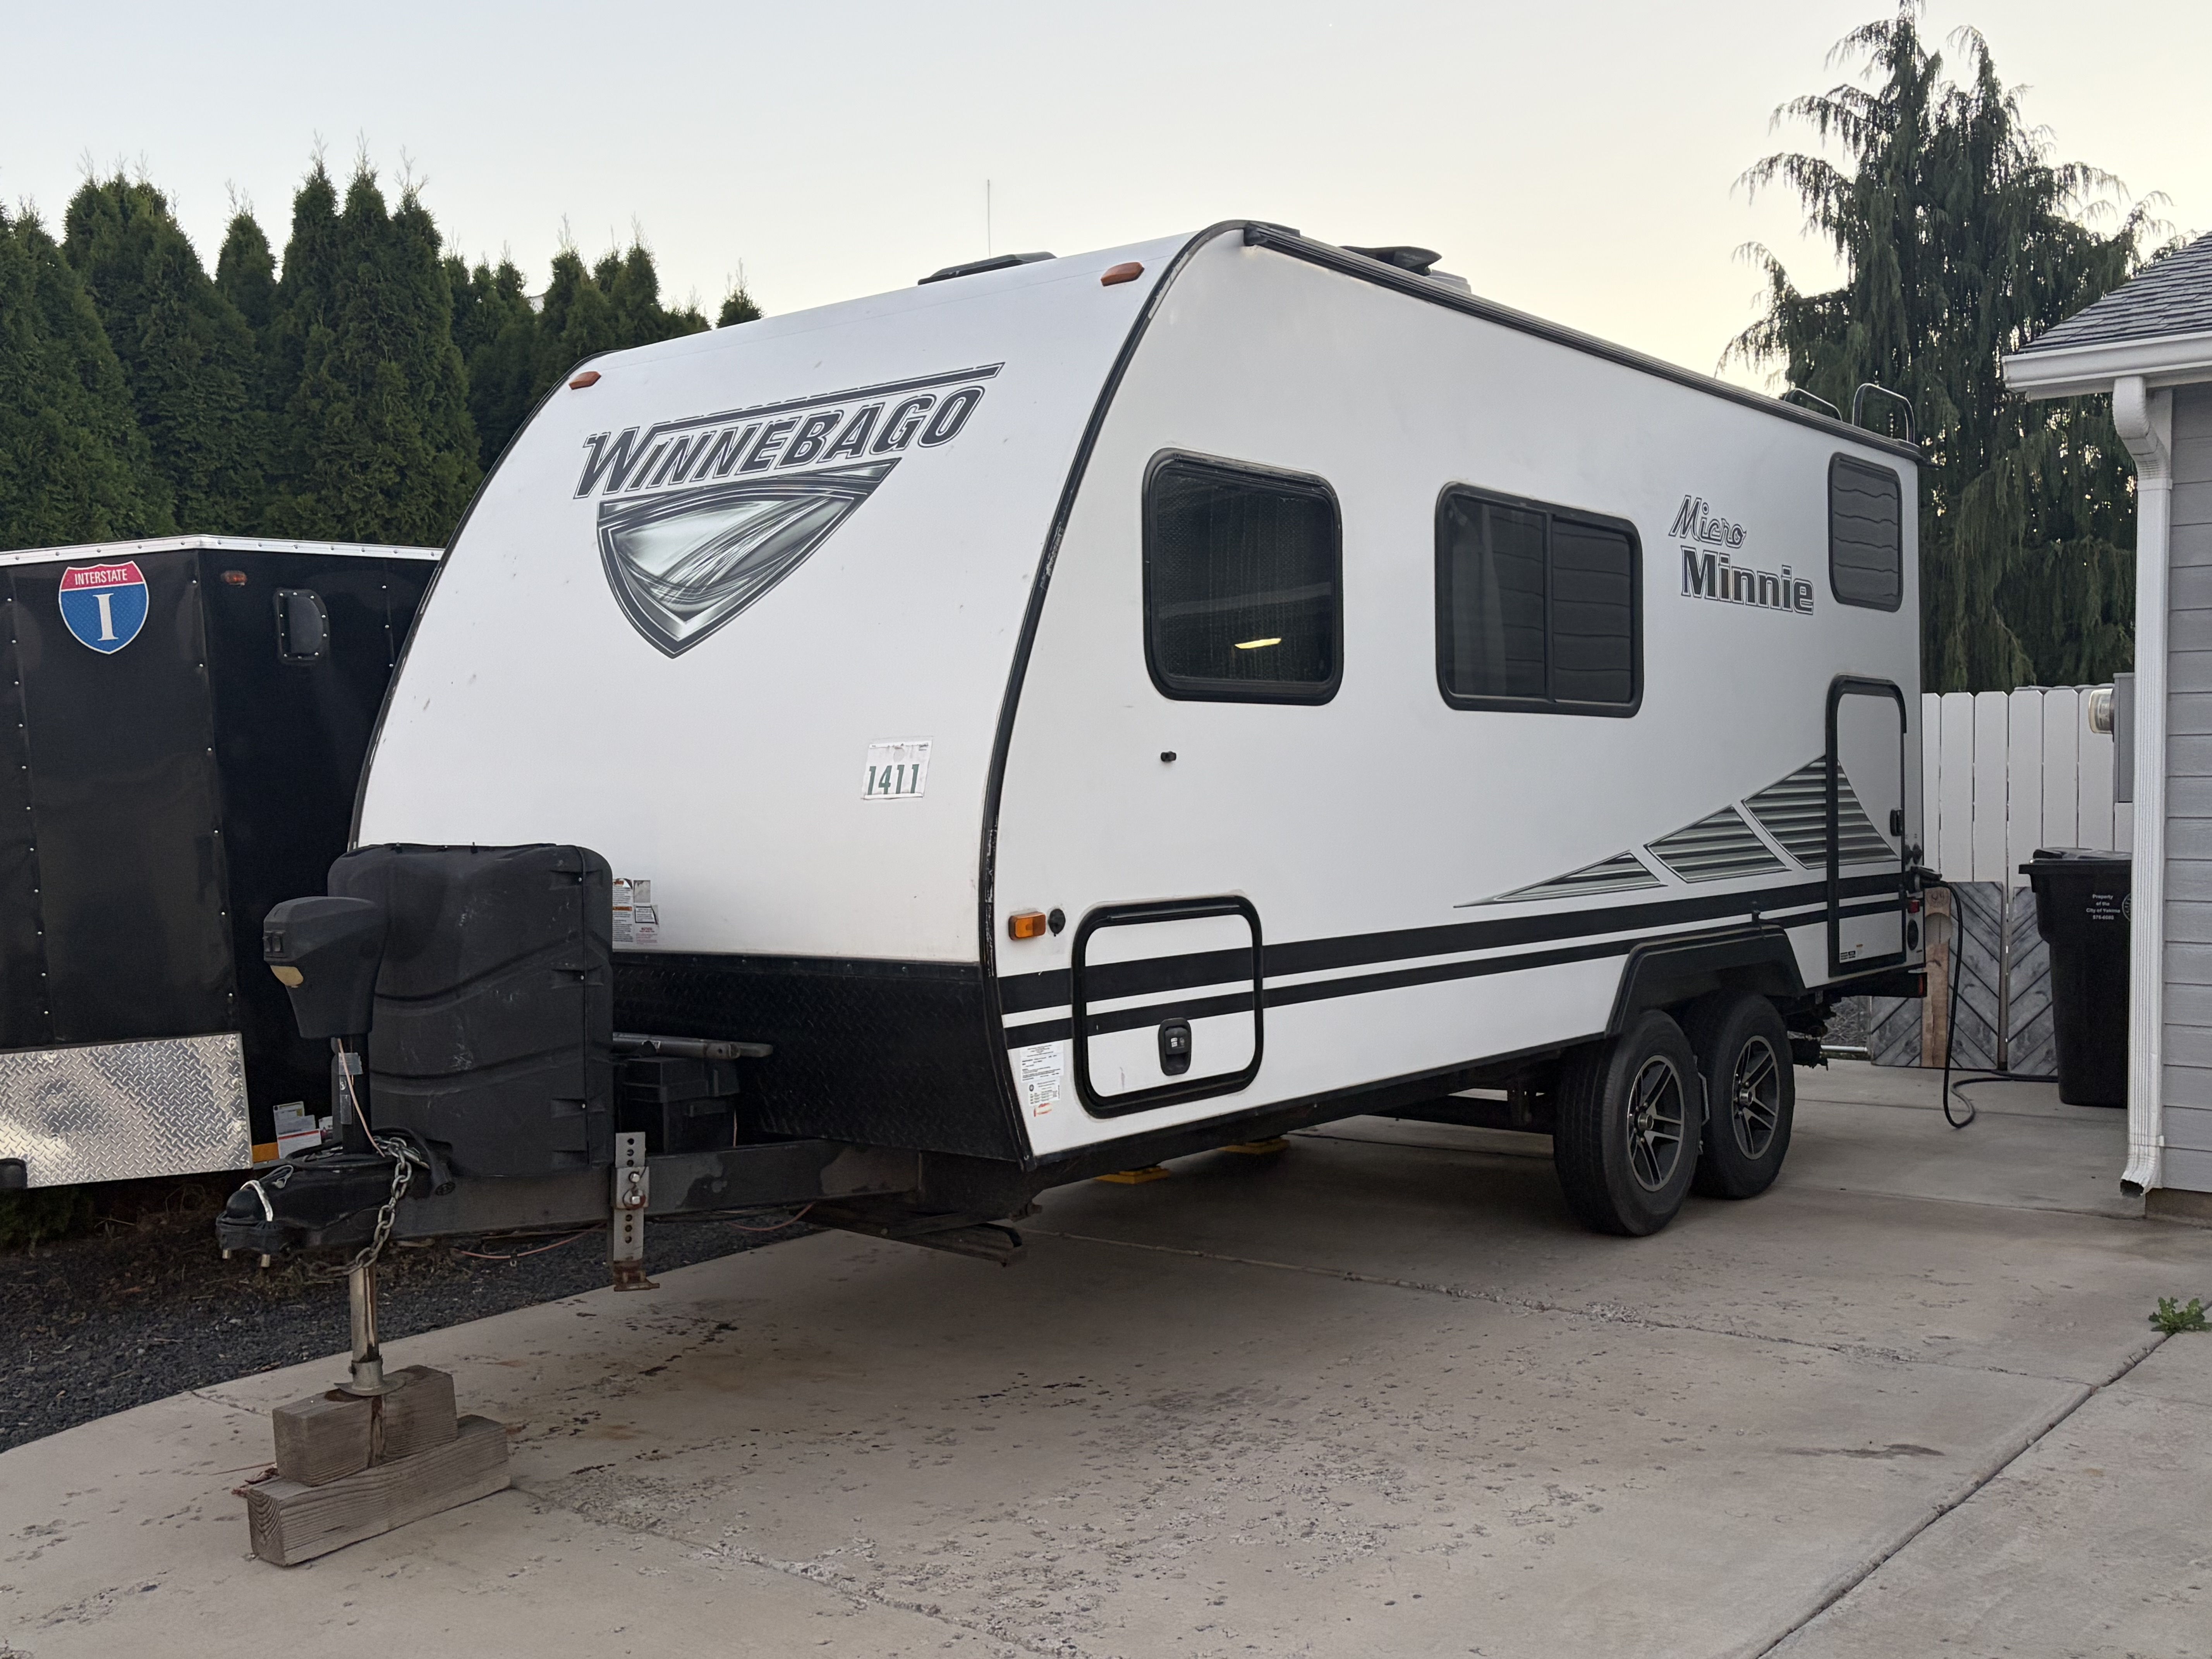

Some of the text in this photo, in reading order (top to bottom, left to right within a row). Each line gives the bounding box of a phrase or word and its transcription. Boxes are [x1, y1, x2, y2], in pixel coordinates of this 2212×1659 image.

[573, 386, 985, 498] WINNEBAGO
[1668, 495, 1747, 549] Micro
[75, 568, 127, 585] INTERSTATE
[1681, 545, 1814, 615] Minnie
[93, 593, 119, 641] I
[867, 764, 919, 795] 1411
